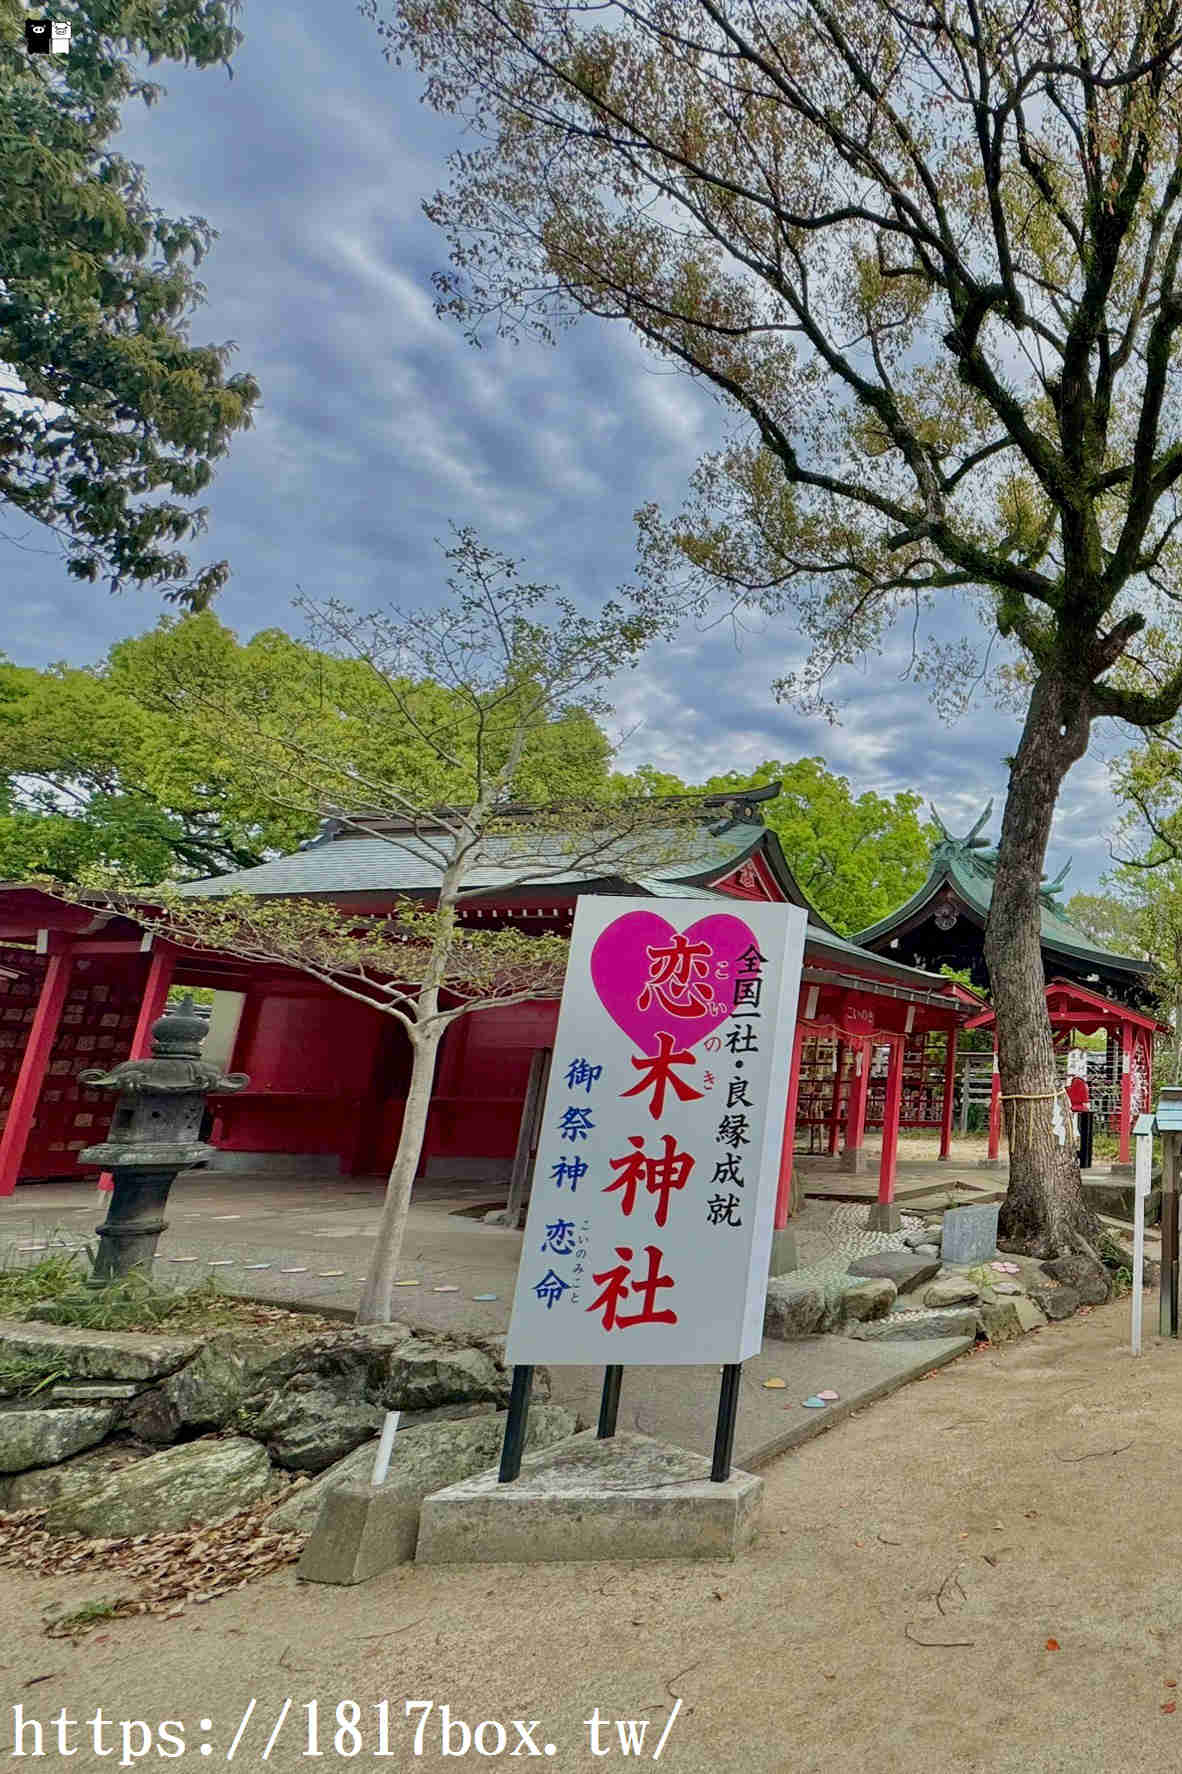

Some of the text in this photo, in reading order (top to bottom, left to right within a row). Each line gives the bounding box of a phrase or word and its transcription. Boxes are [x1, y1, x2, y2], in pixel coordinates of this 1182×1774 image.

[531, 1057, 603, 1310] 御祭神 恋命
[585, 934, 714, 1332] 恋木神社
[706, 943, 769, 1228] 全国一社・良縁成就
[569, 1218, 590, 1304] こいのみこと
